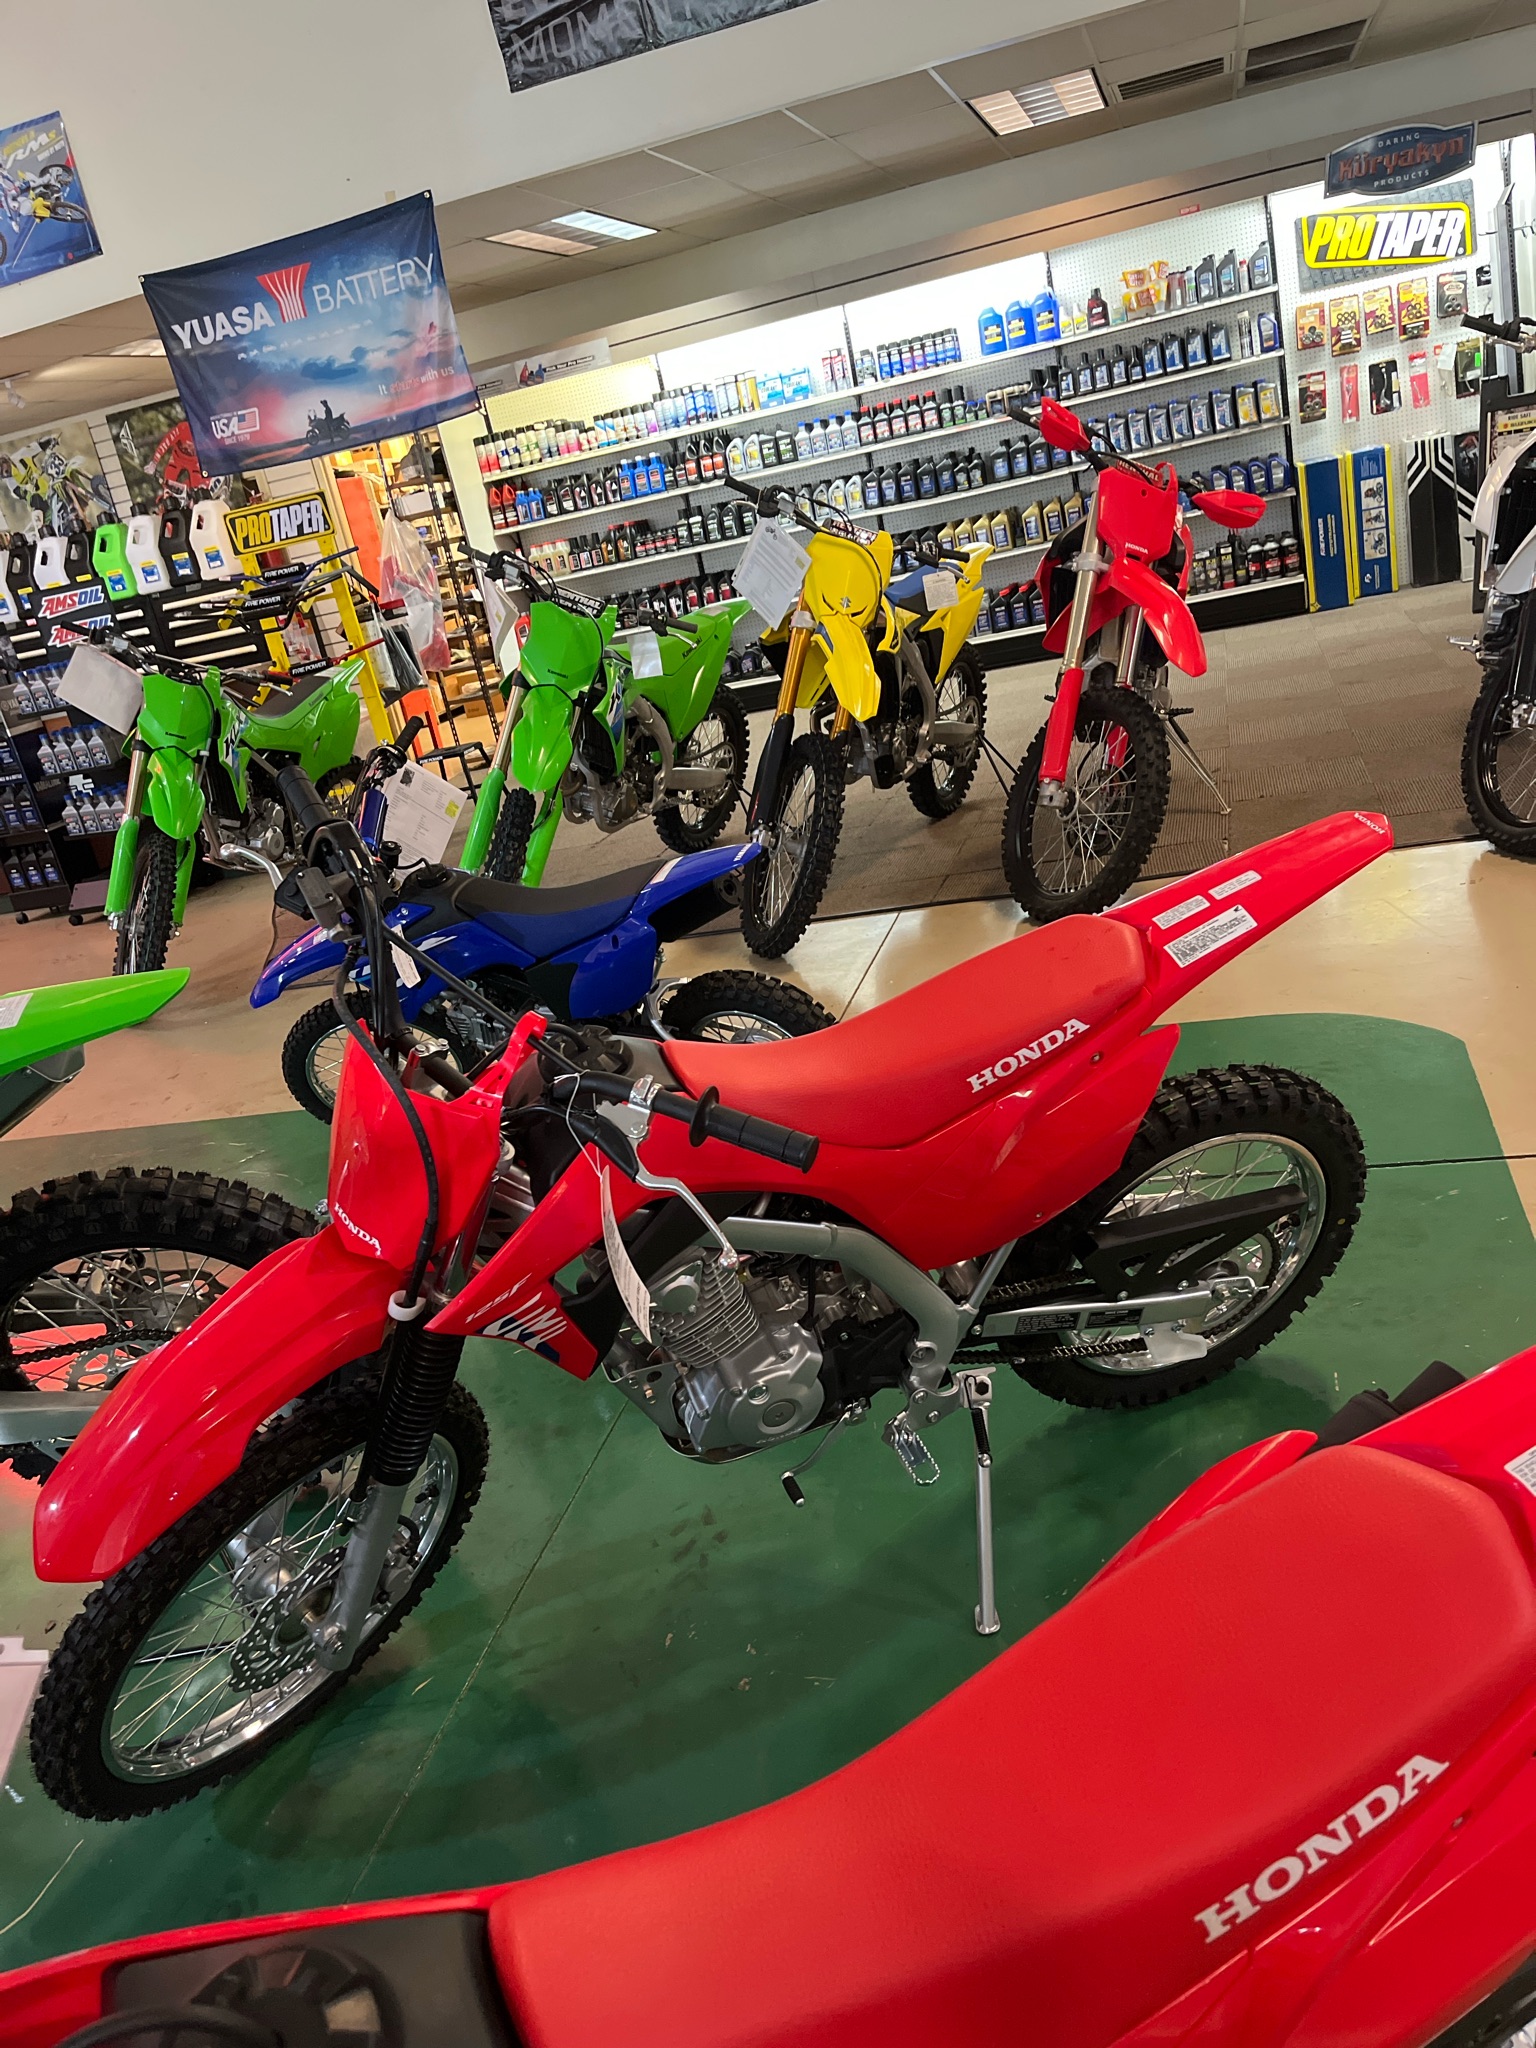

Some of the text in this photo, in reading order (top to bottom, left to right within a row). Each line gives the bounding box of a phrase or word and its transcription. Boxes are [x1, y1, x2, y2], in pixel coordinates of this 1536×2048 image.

[1378, 132, 1420, 148] DARING
[1373, 169, 1430, 188] PRODUCTS
[1309, 210, 1466, 262] PROTAPER
[171, 253, 435, 350] YUASA BATTERY
[378, 384, 388, 395] It
[420, 369, 438, 383] with
[440, 366, 455, 377] us
[211, 416, 239, 439] USA
[234, 500, 325, 551] PROTAPER
[1124, 542, 1149, 555] HONDA
[39, 585, 104, 618] AMSOIL
[966, 1018, 1090, 1094] HONDA
[334, 1201, 381, 1256] HONDA
[465, 1272, 533, 1324] 125F
[1194, 1754, 1450, 1944] HONDA
